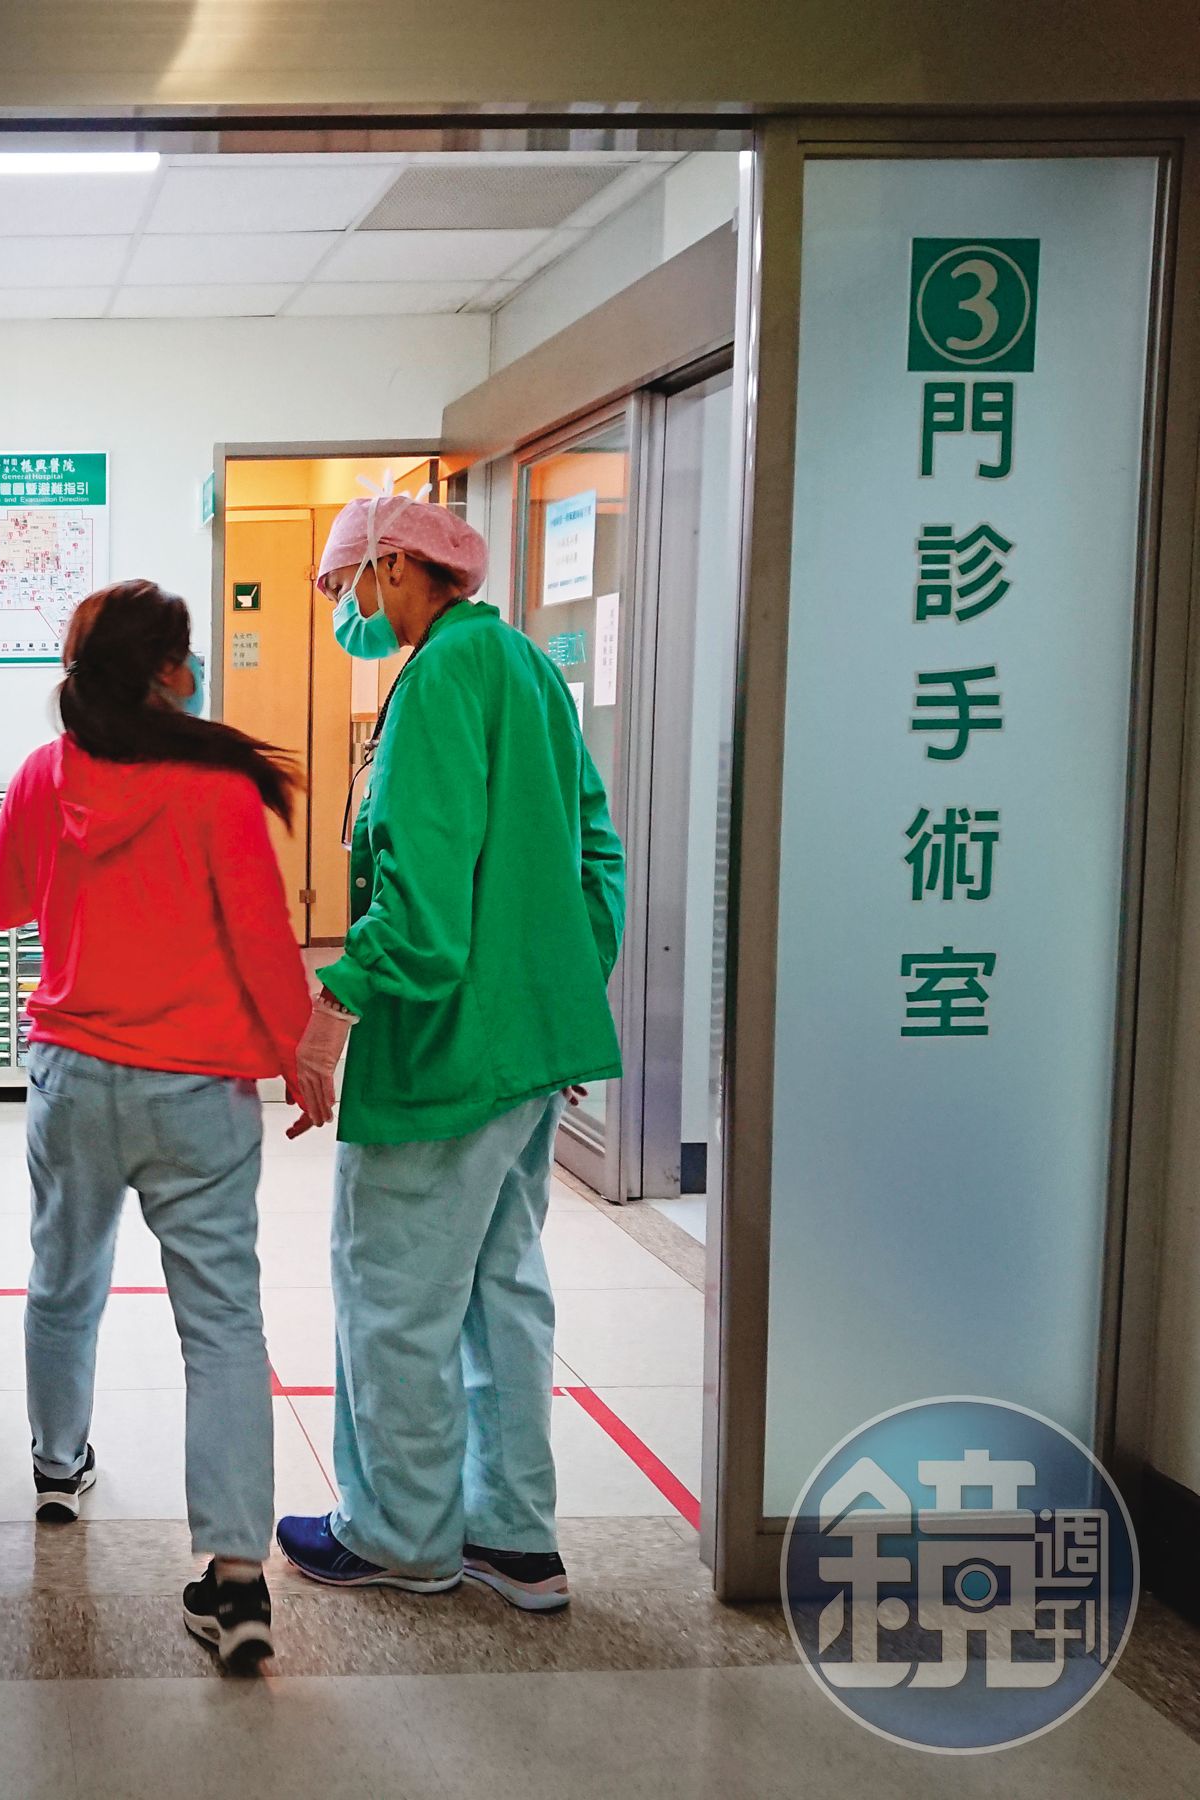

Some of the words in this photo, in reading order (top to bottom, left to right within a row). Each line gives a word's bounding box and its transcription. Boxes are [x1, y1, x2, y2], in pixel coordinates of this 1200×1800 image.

[947, 259, 1000, 352] 3
[900, 381, 1016, 1038] 門診手術室
